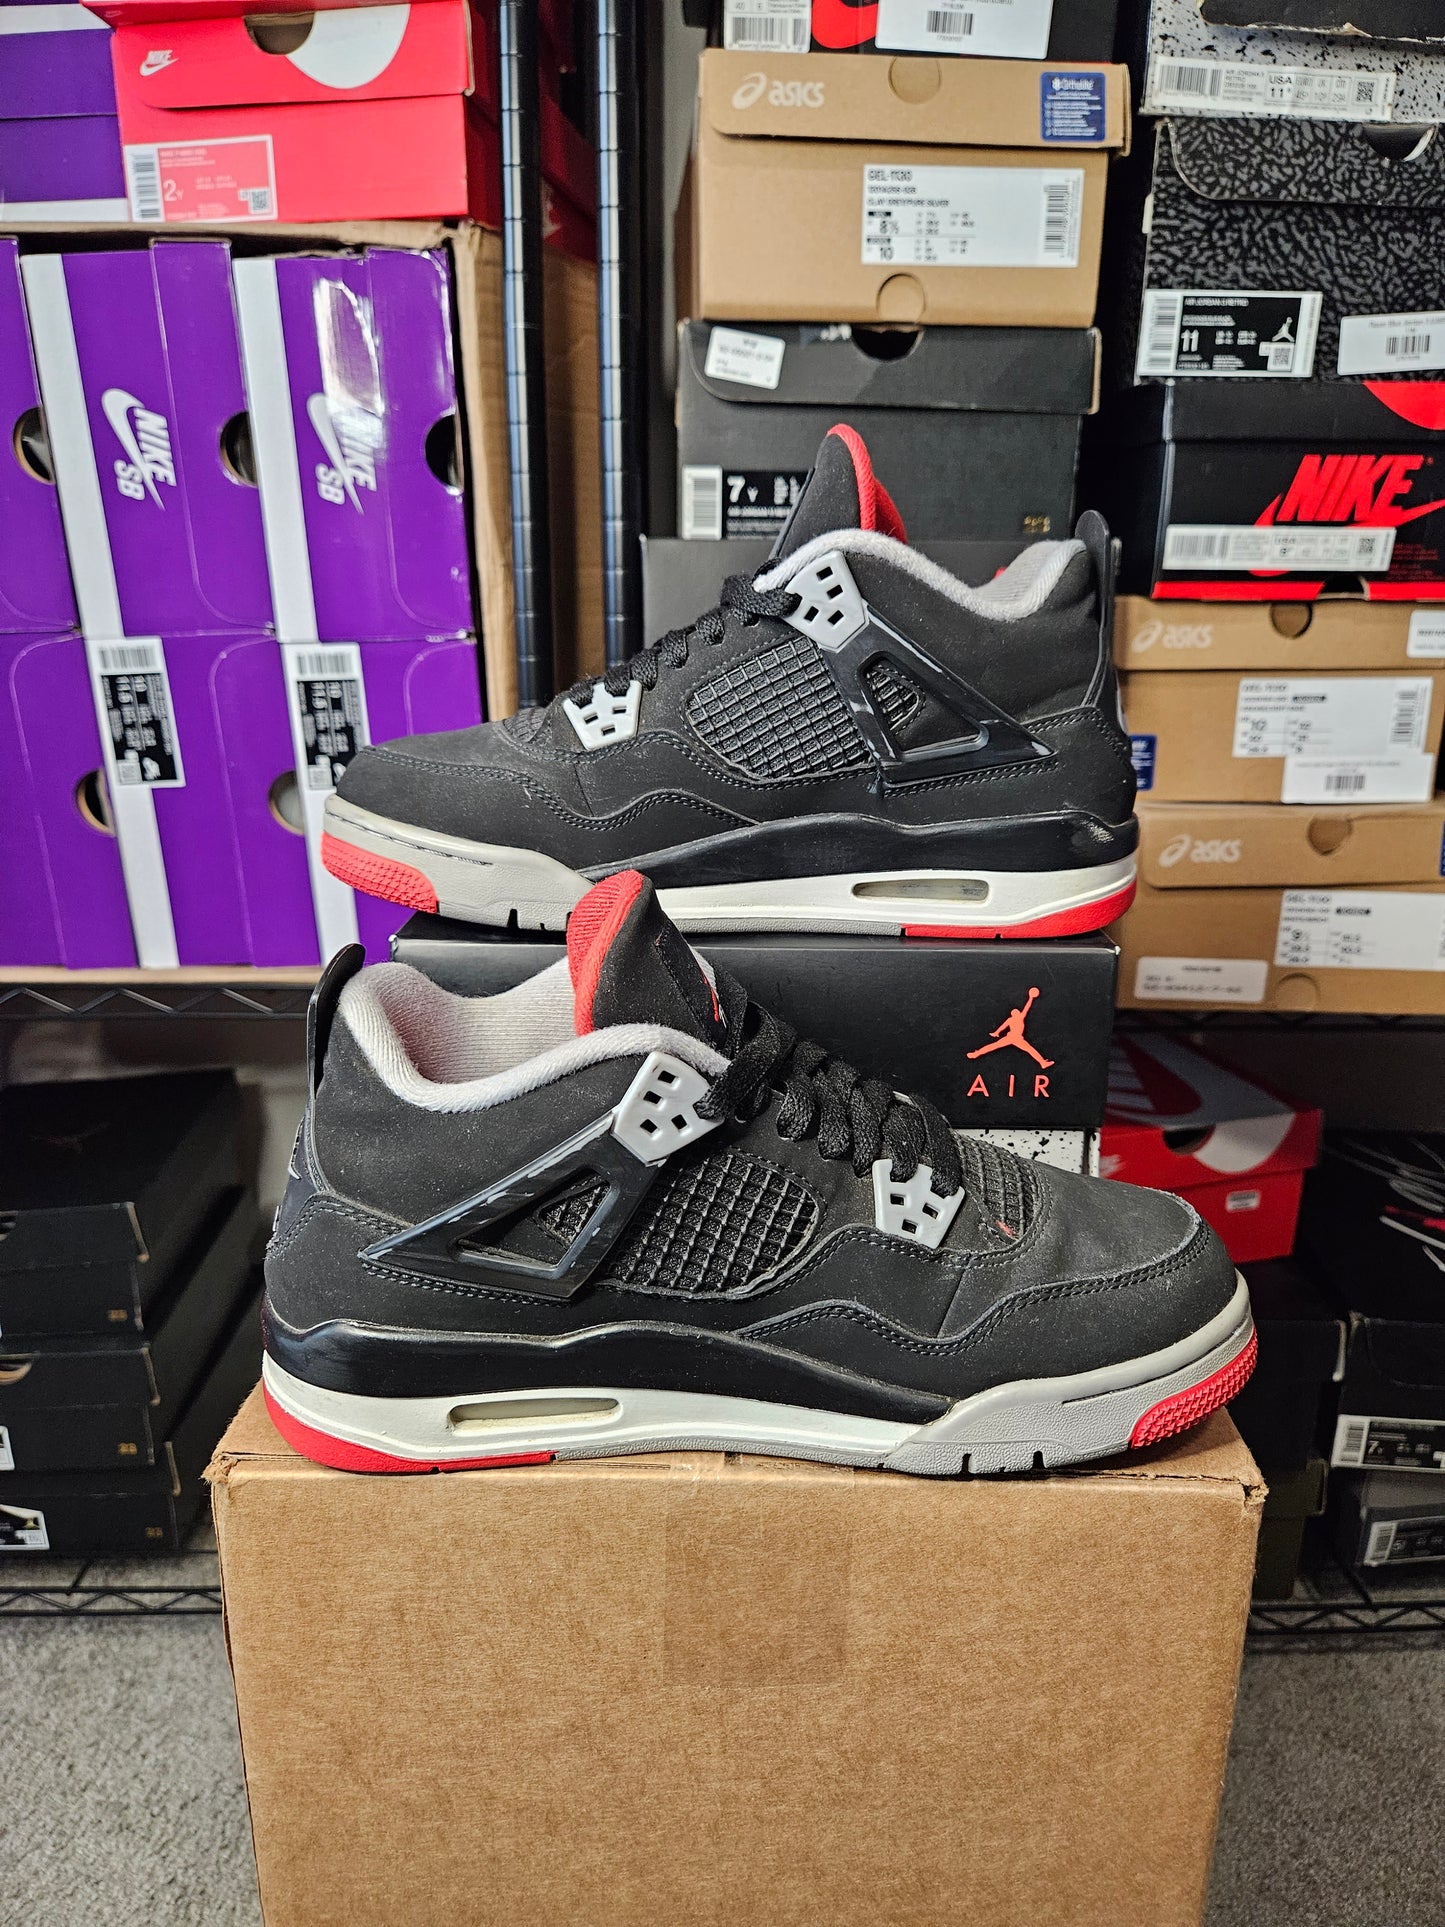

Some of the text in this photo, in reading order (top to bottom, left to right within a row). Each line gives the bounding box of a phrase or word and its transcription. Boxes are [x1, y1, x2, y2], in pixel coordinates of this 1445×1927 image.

[147, 49, 173, 65] NIKE
[1269, 74, 1292, 84] USA
[767, 80, 825, 108] asics
[1181, 329, 1200, 352] 11
[133, 406, 177, 487] NIKE
[113, 459, 146, 501] SB
[315, 463, 345, 505] SB
[1276, 454, 1424, 522] NIKE
[1163, 624, 1213, 649] asics
[1191, 839, 1242, 863] asics
[966, 1074, 1050, 1098] AIR
